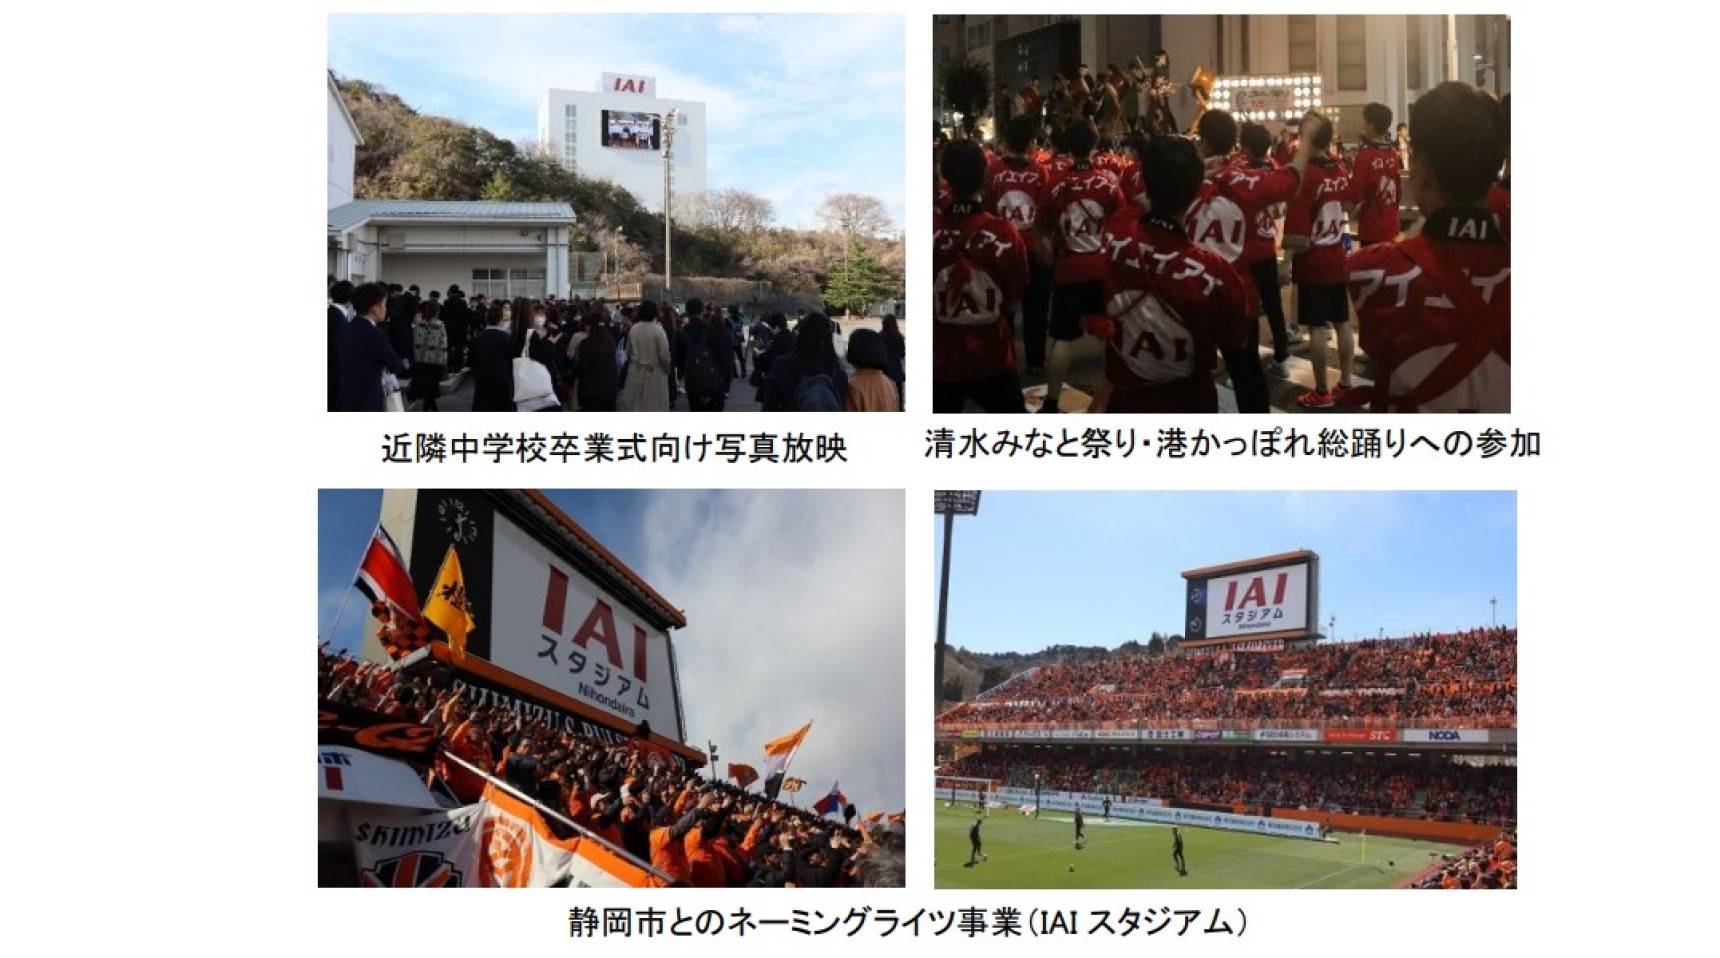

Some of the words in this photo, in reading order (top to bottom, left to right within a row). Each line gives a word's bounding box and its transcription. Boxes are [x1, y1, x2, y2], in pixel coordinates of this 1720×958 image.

[614, 77, 646, 94] IAI
[1187, 219, 1241, 243] IAI
[1448, 217, 1488, 239] IAI
[939, 288, 996, 318] IAI
[1225, 572, 1288, 611] IAI
[542, 563, 648, 684] IAI
[1222, 608, 1283, 625] スタジアム
[537, 633, 649, 710] スタジアム
[578, 681, 636, 718] Nihondaira
[1428, 730, 1461, 741] NODA
